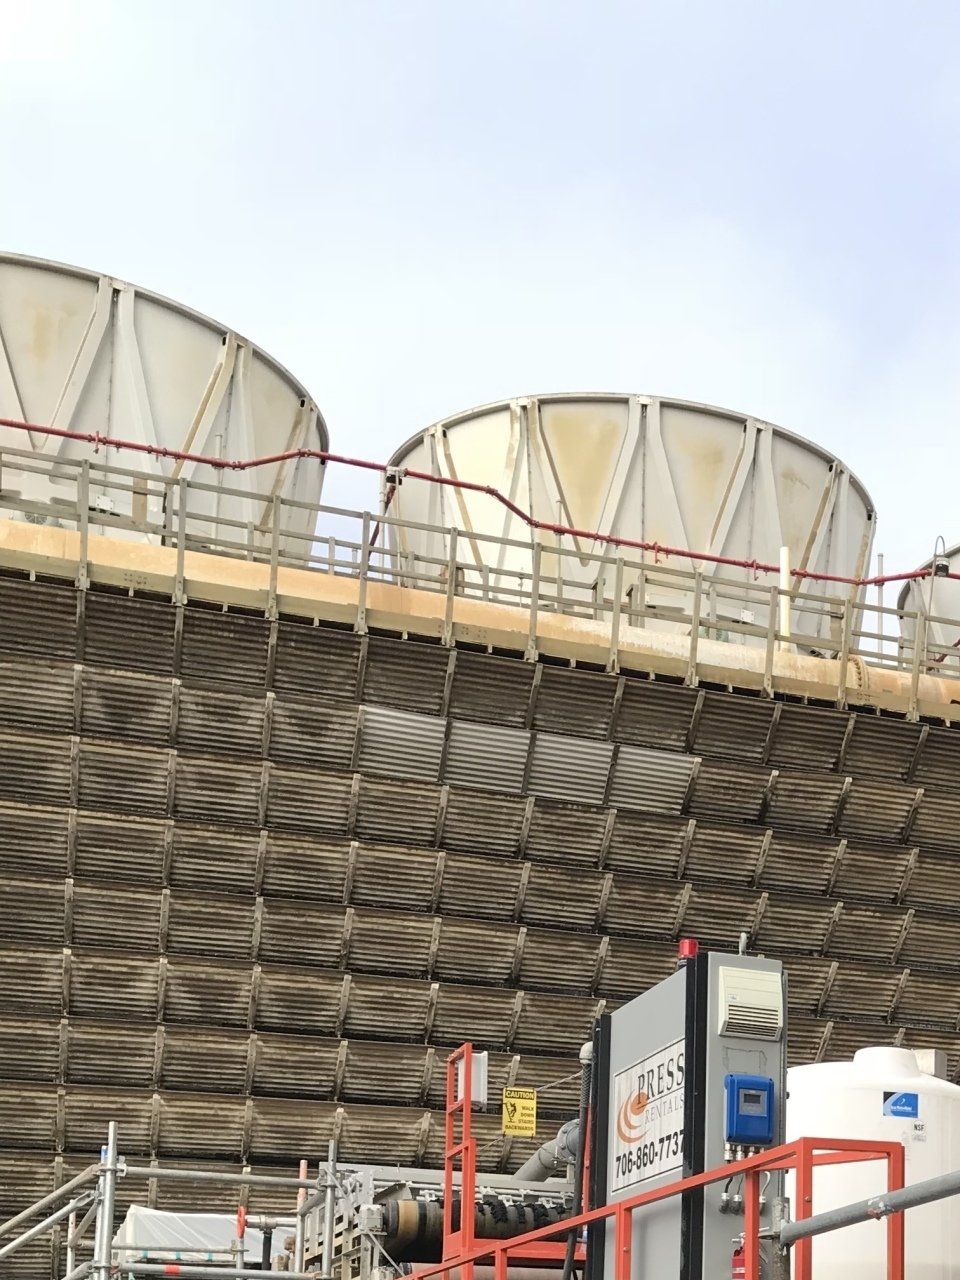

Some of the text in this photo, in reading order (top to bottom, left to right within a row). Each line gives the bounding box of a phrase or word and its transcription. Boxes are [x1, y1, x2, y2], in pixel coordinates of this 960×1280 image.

[505, 1090, 534, 1100] CAUTION
[637, 1052, 684, 1105] PRESS
[644, 1092, 684, 1126] RENTALS
[913, 1123, 925, 1132] NSF
[615, 1128, 684, 1179] 706-860-7737
